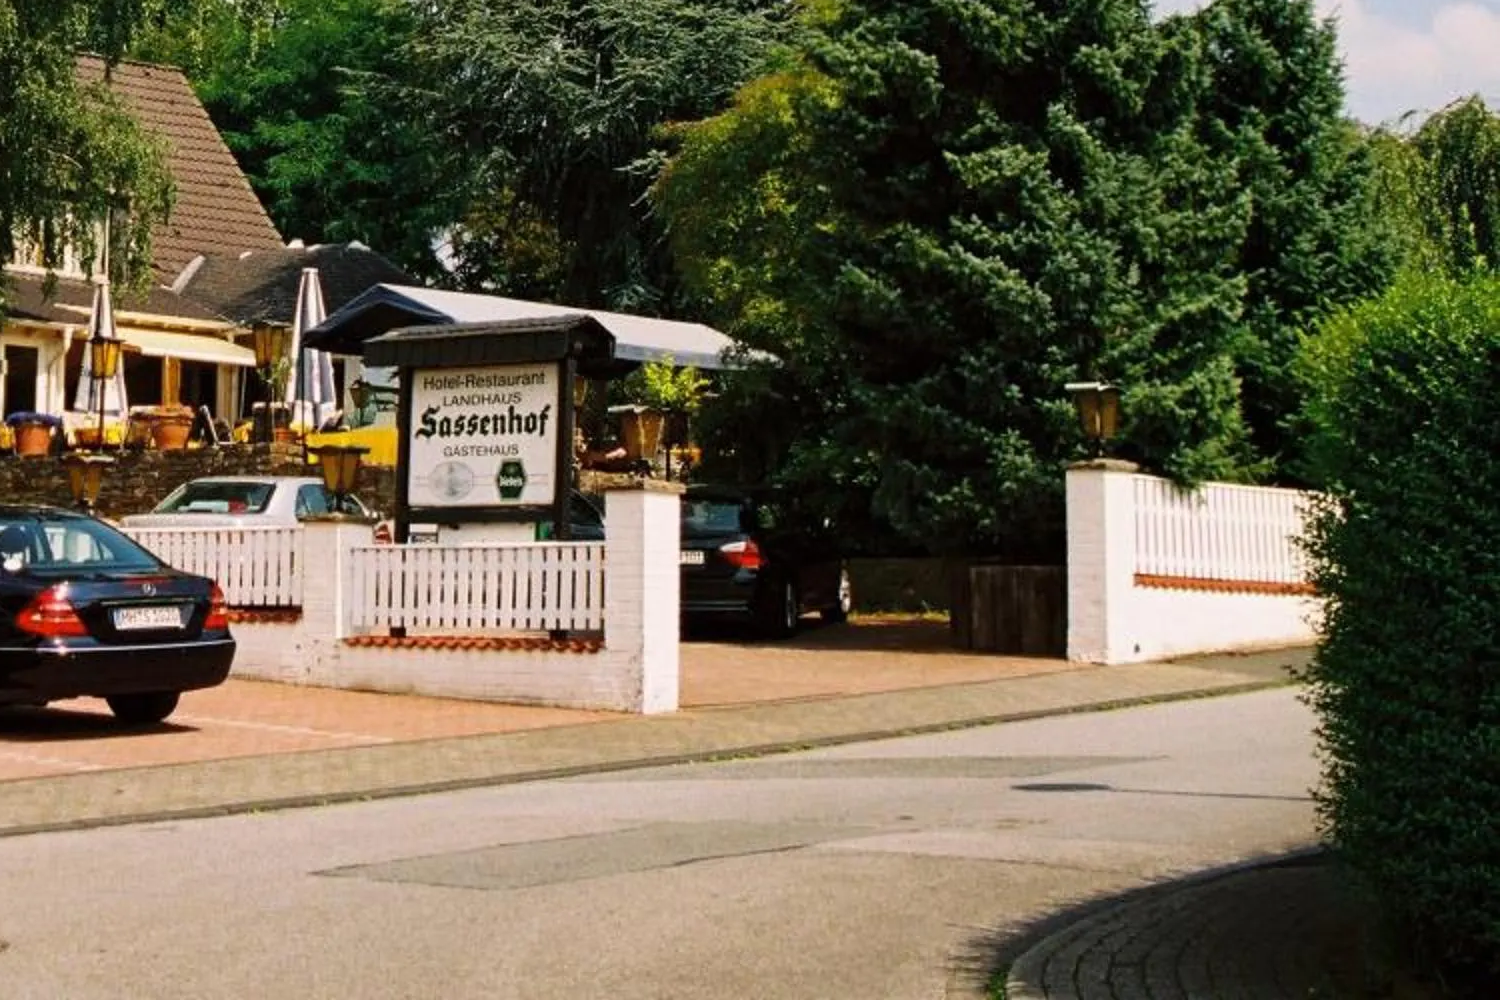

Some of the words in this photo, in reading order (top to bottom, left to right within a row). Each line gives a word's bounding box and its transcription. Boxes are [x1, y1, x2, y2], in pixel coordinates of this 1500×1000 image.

[423, 372, 546, 391] Hotel-Restaurant
[443, 391, 522, 407] LANDHAUS
[415, 403, 551, 439] Sassenhof
